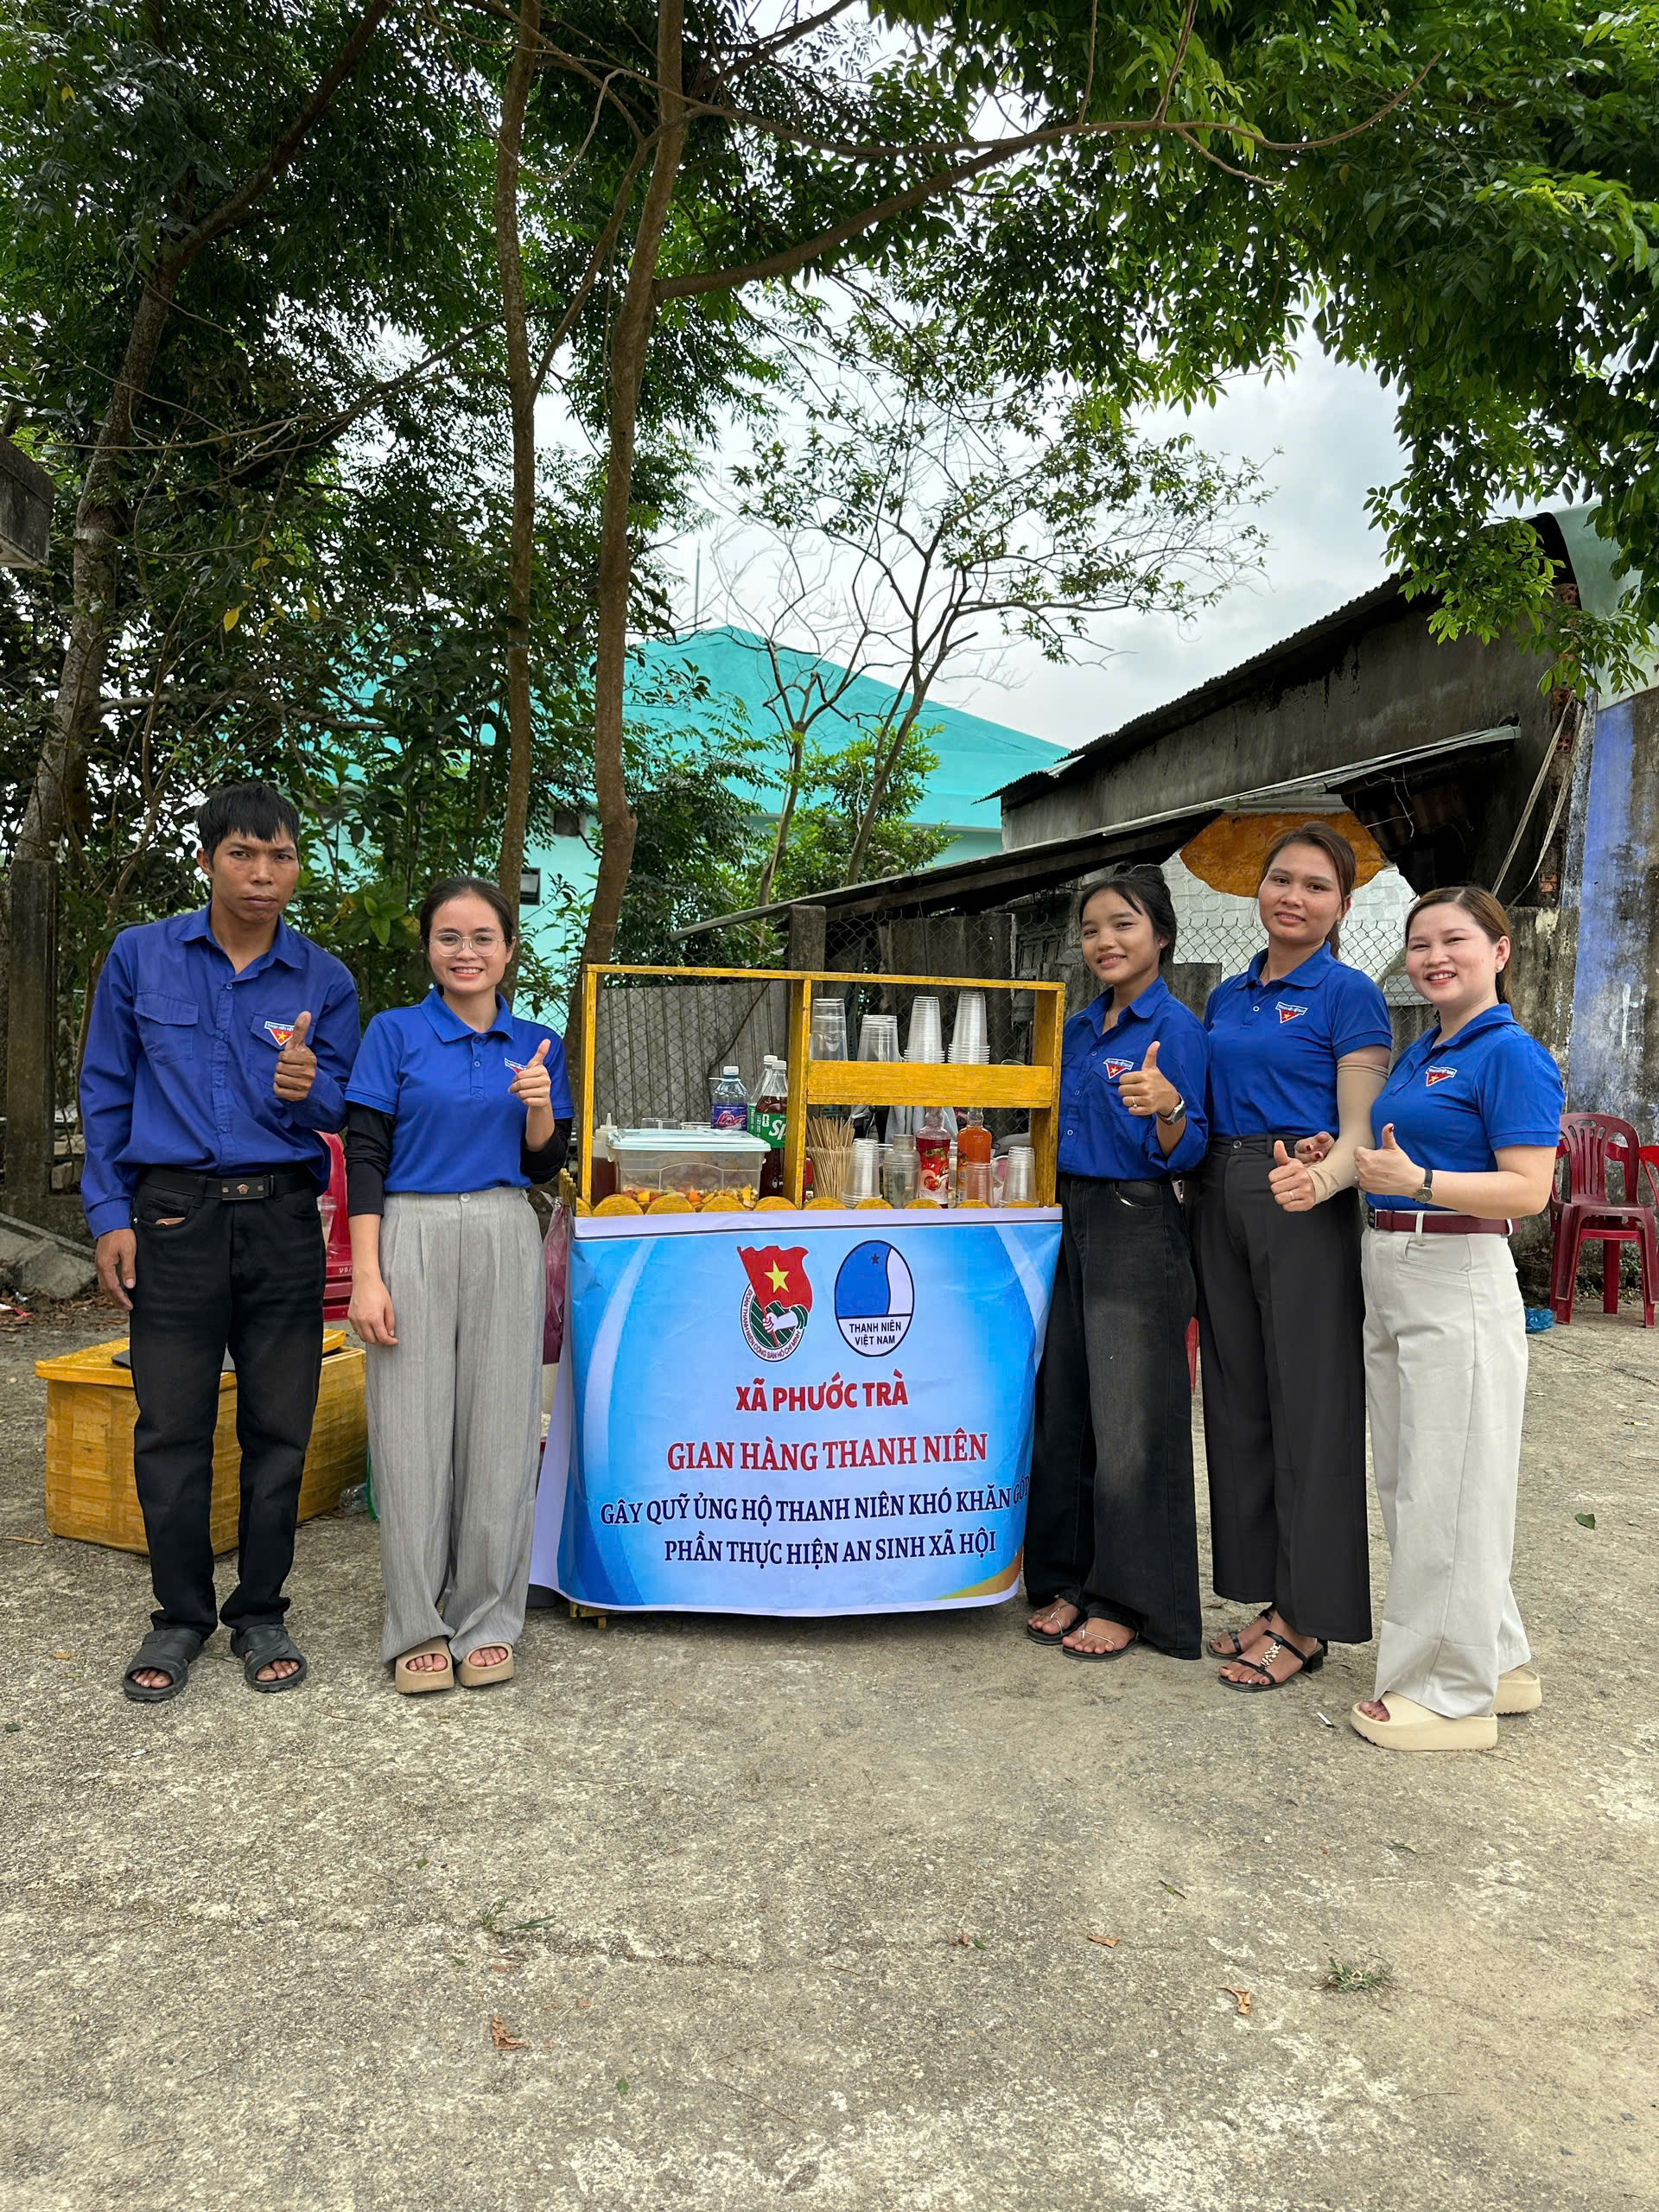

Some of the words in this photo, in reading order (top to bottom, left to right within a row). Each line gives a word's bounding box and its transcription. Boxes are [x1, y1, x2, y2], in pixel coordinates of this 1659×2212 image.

[849, 1321, 879, 1333] THANH
[880, 1319, 902, 1332] NIÊN
[855, 1333, 875, 1348] VIỆT
[876, 1334, 896, 1345] NAM
[735, 1376, 768, 1412] XÃ
[772, 1371, 858, 1412] PHƯỚC
[862, 1368, 909, 1408] TRÀ
[667, 1441, 735, 1471] GIAN
[740, 1435, 819, 1471] HÀNG
[822, 1436, 918, 1470] THANH
[922, 1427, 988, 1464] NIÊN
[601, 1498, 644, 1525] GÂY
[646, 1492, 690, 1525] QUỸ
[693, 1491, 738, 1520] ỦNG
[741, 1494, 772, 1528] HỘ
[776, 1497, 850, 1522] THANH
[854, 1490, 905, 1519] NIÊN
[908, 1486, 952, 1516] KHÓ
[956, 1484, 1012, 1513] KHĂN
[664, 1530, 723, 1562] PHẦN
[727, 1539, 782, 1570] THỰC
[786, 1537, 839, 1570] HIỆN
[842, 1540, 872, 1563] AN
[874, 1535, 925, 1560] SINH
[928, 1529, 957, 1557] XÃ
[959, 1526, 996, 1559] HỘI
